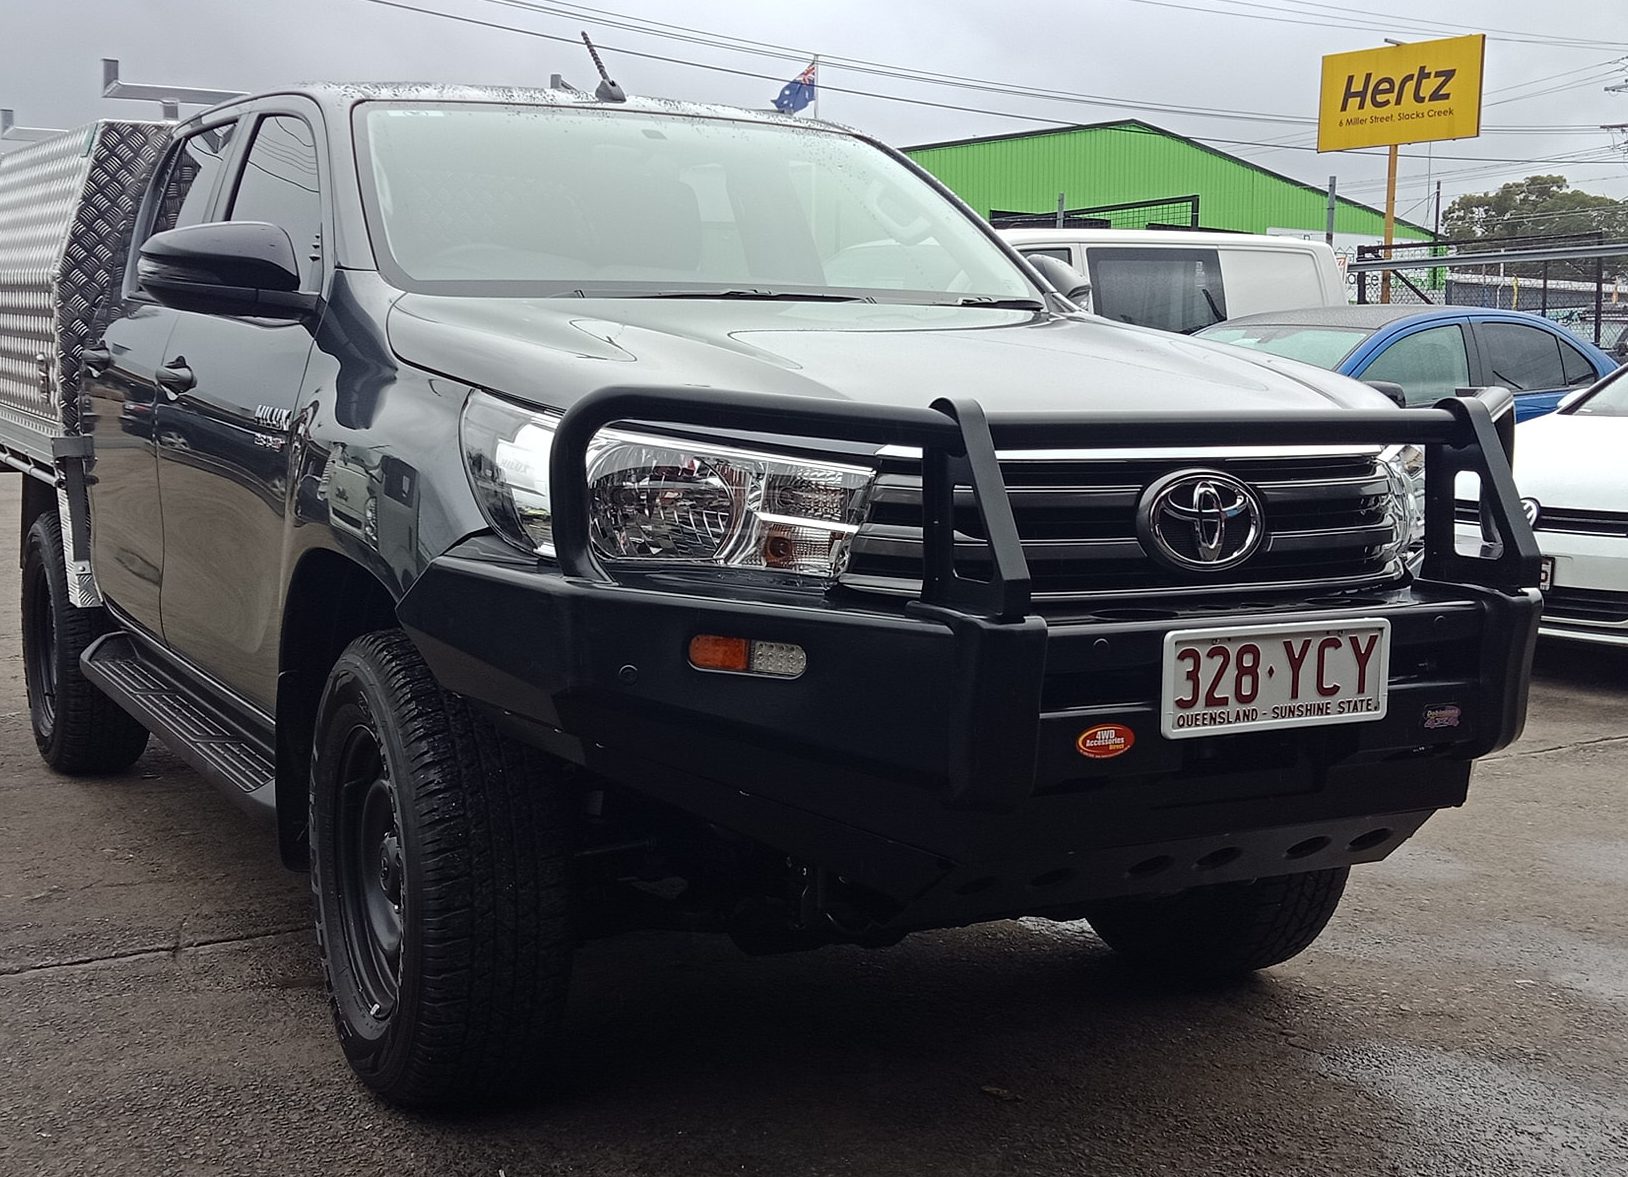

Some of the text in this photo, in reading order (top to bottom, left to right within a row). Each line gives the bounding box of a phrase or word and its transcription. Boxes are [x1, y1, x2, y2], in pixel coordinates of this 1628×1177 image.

[1339, 65, 1457, 112] Hertz
[1345, 117, 1368, 127] Miller
[1397, 111, 1425, 122] Slacks
[1426, 107, 1454, 119] Creek
[1174, 634, 1379, 710] 328 YCY
[1177, 707, 1259, 728] QUEENSLAND
[1272, 701, 1332, 719] SUNSHINE
[1096, 730, 1115, 740] 4WD
